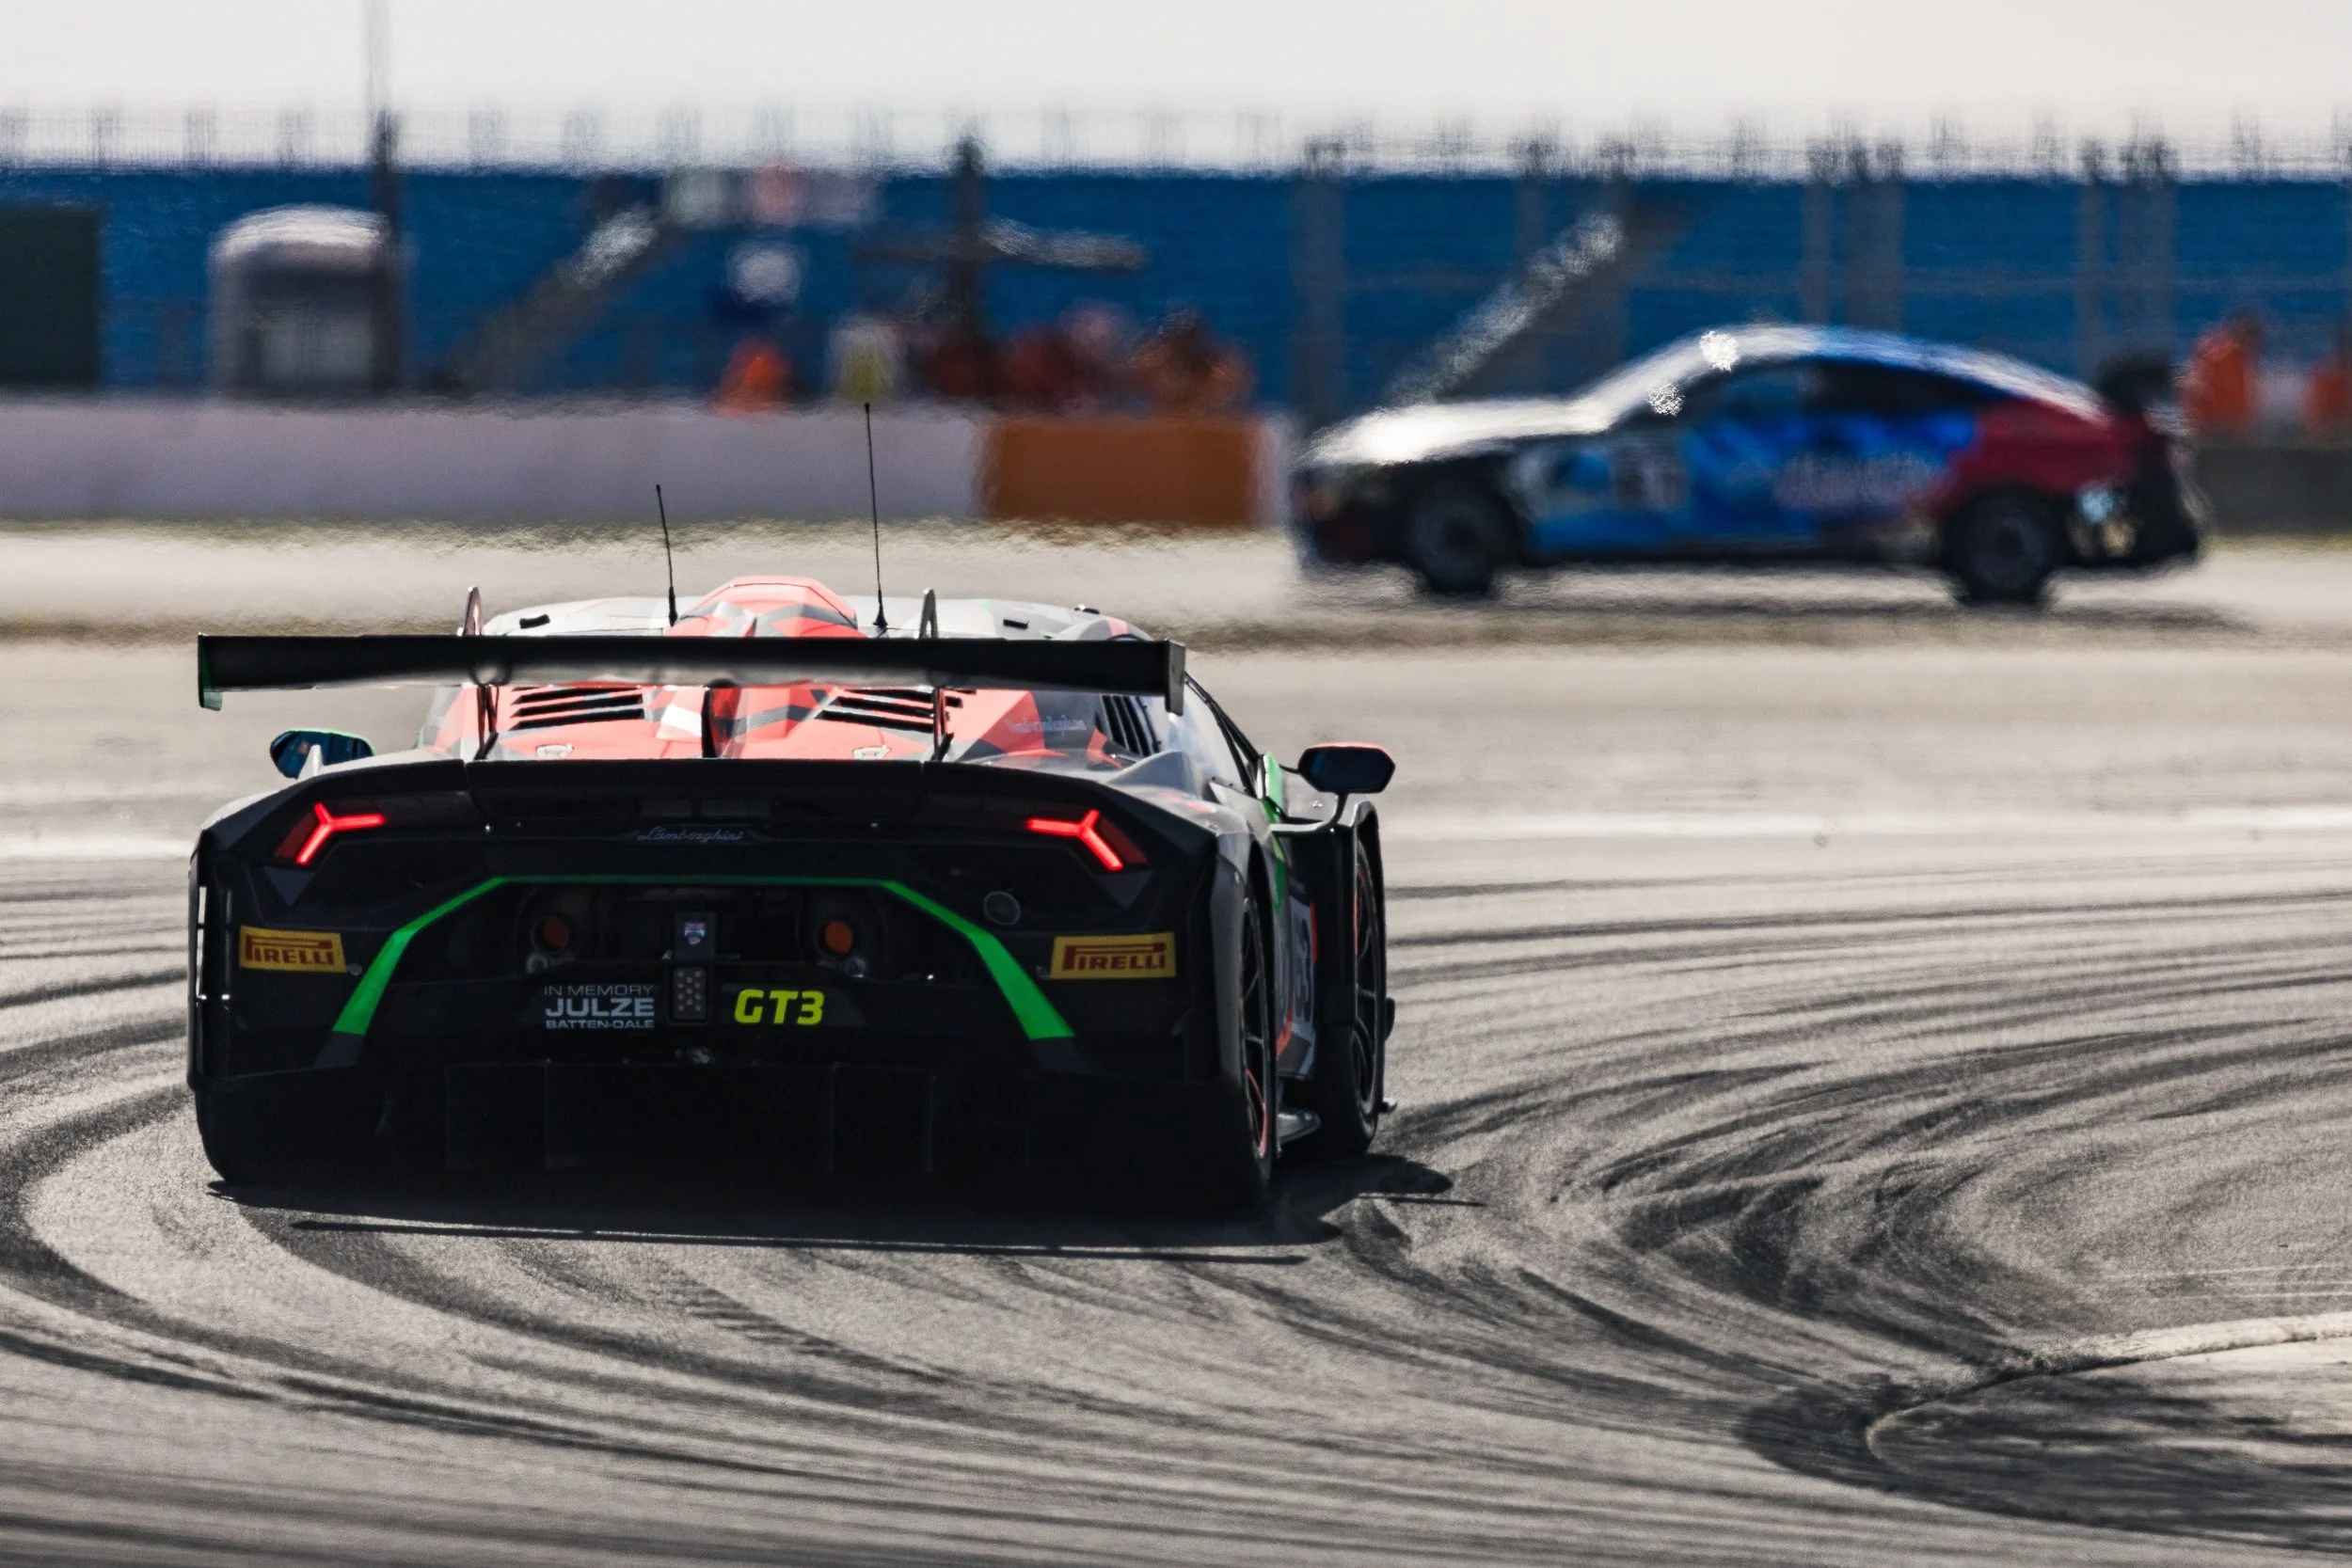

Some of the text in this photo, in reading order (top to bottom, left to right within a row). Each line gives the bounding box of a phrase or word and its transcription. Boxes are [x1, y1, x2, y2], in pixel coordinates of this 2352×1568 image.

[245, 933, 335, 966] PIRELLI
[1062, 942, 1167, 971] PIRELLI
[545, 985, 655, 996] IN MEMORY
[545, 998, 656, 1017] JULZE
[734, 988, 826, 1025] GT3
[545, 1020, 656, 1030] BATTEN-DALE
